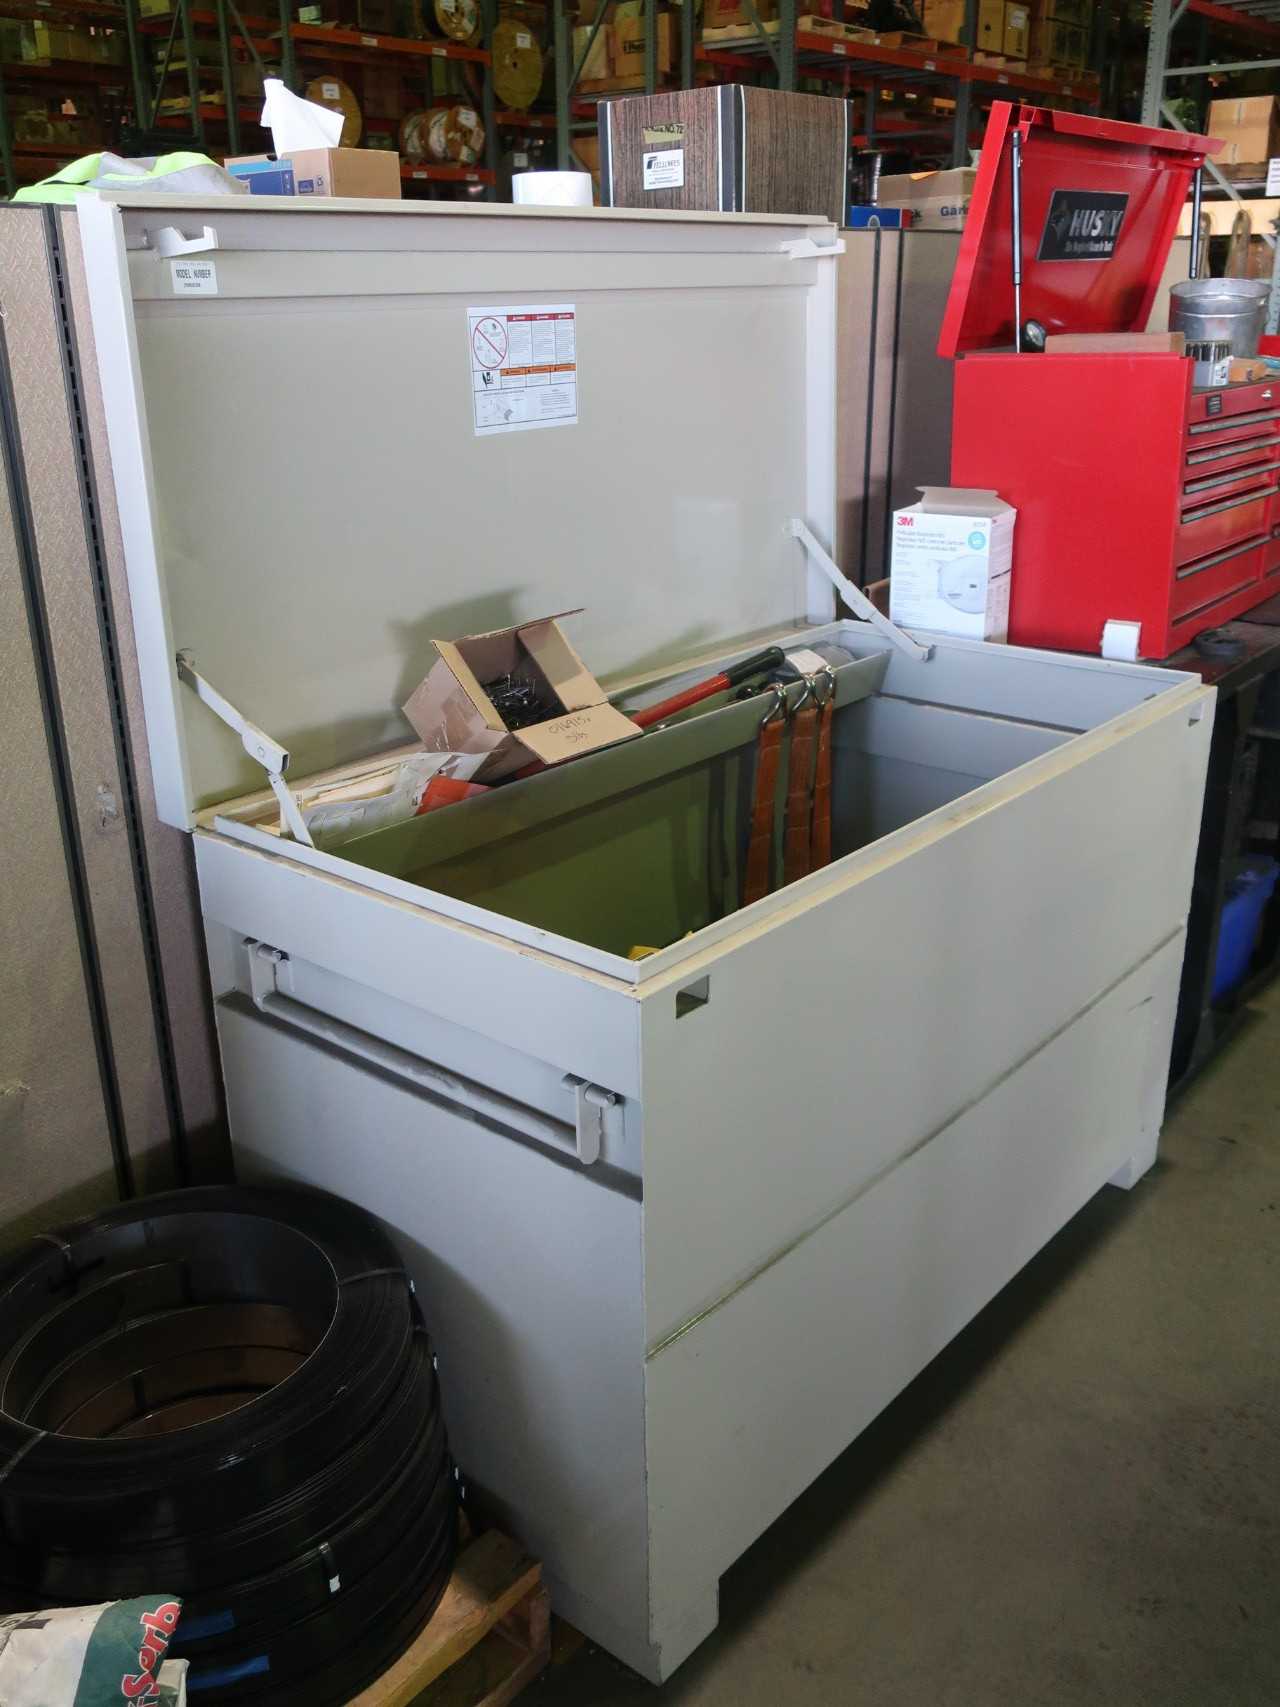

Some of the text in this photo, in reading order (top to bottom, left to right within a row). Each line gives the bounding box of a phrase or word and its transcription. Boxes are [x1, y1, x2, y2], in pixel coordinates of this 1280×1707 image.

[175, 269, 211, 279] MODEL NUMBER
[897, 516, 914, 527] 3M
